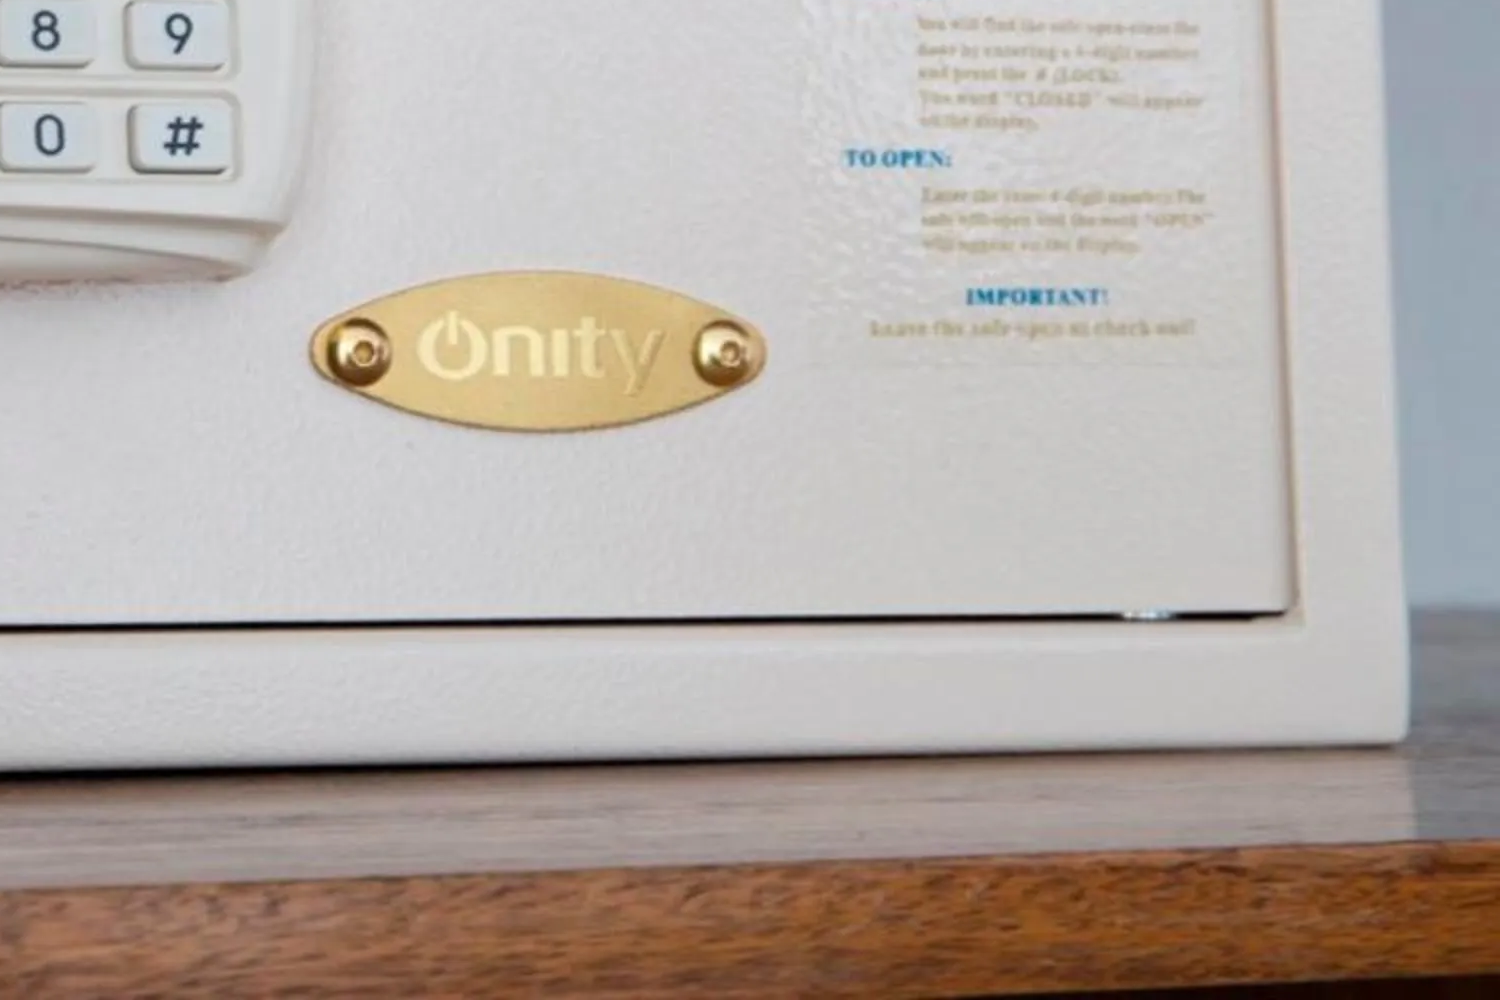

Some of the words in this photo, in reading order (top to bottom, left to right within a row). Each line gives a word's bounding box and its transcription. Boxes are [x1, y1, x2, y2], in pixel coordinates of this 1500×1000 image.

[30, 9, 61, 51] 8
[164, 12, 194, 54] 9
[33, 113, 65, 156] 0
[163, 116, 204, 156] #
[844, 148, 877, 168] TO
[881, 149, 953, 169] OPEN:
[964, 287, 1109, 307] IMPORTANT!
[416, 310, 667, 397] Onity
